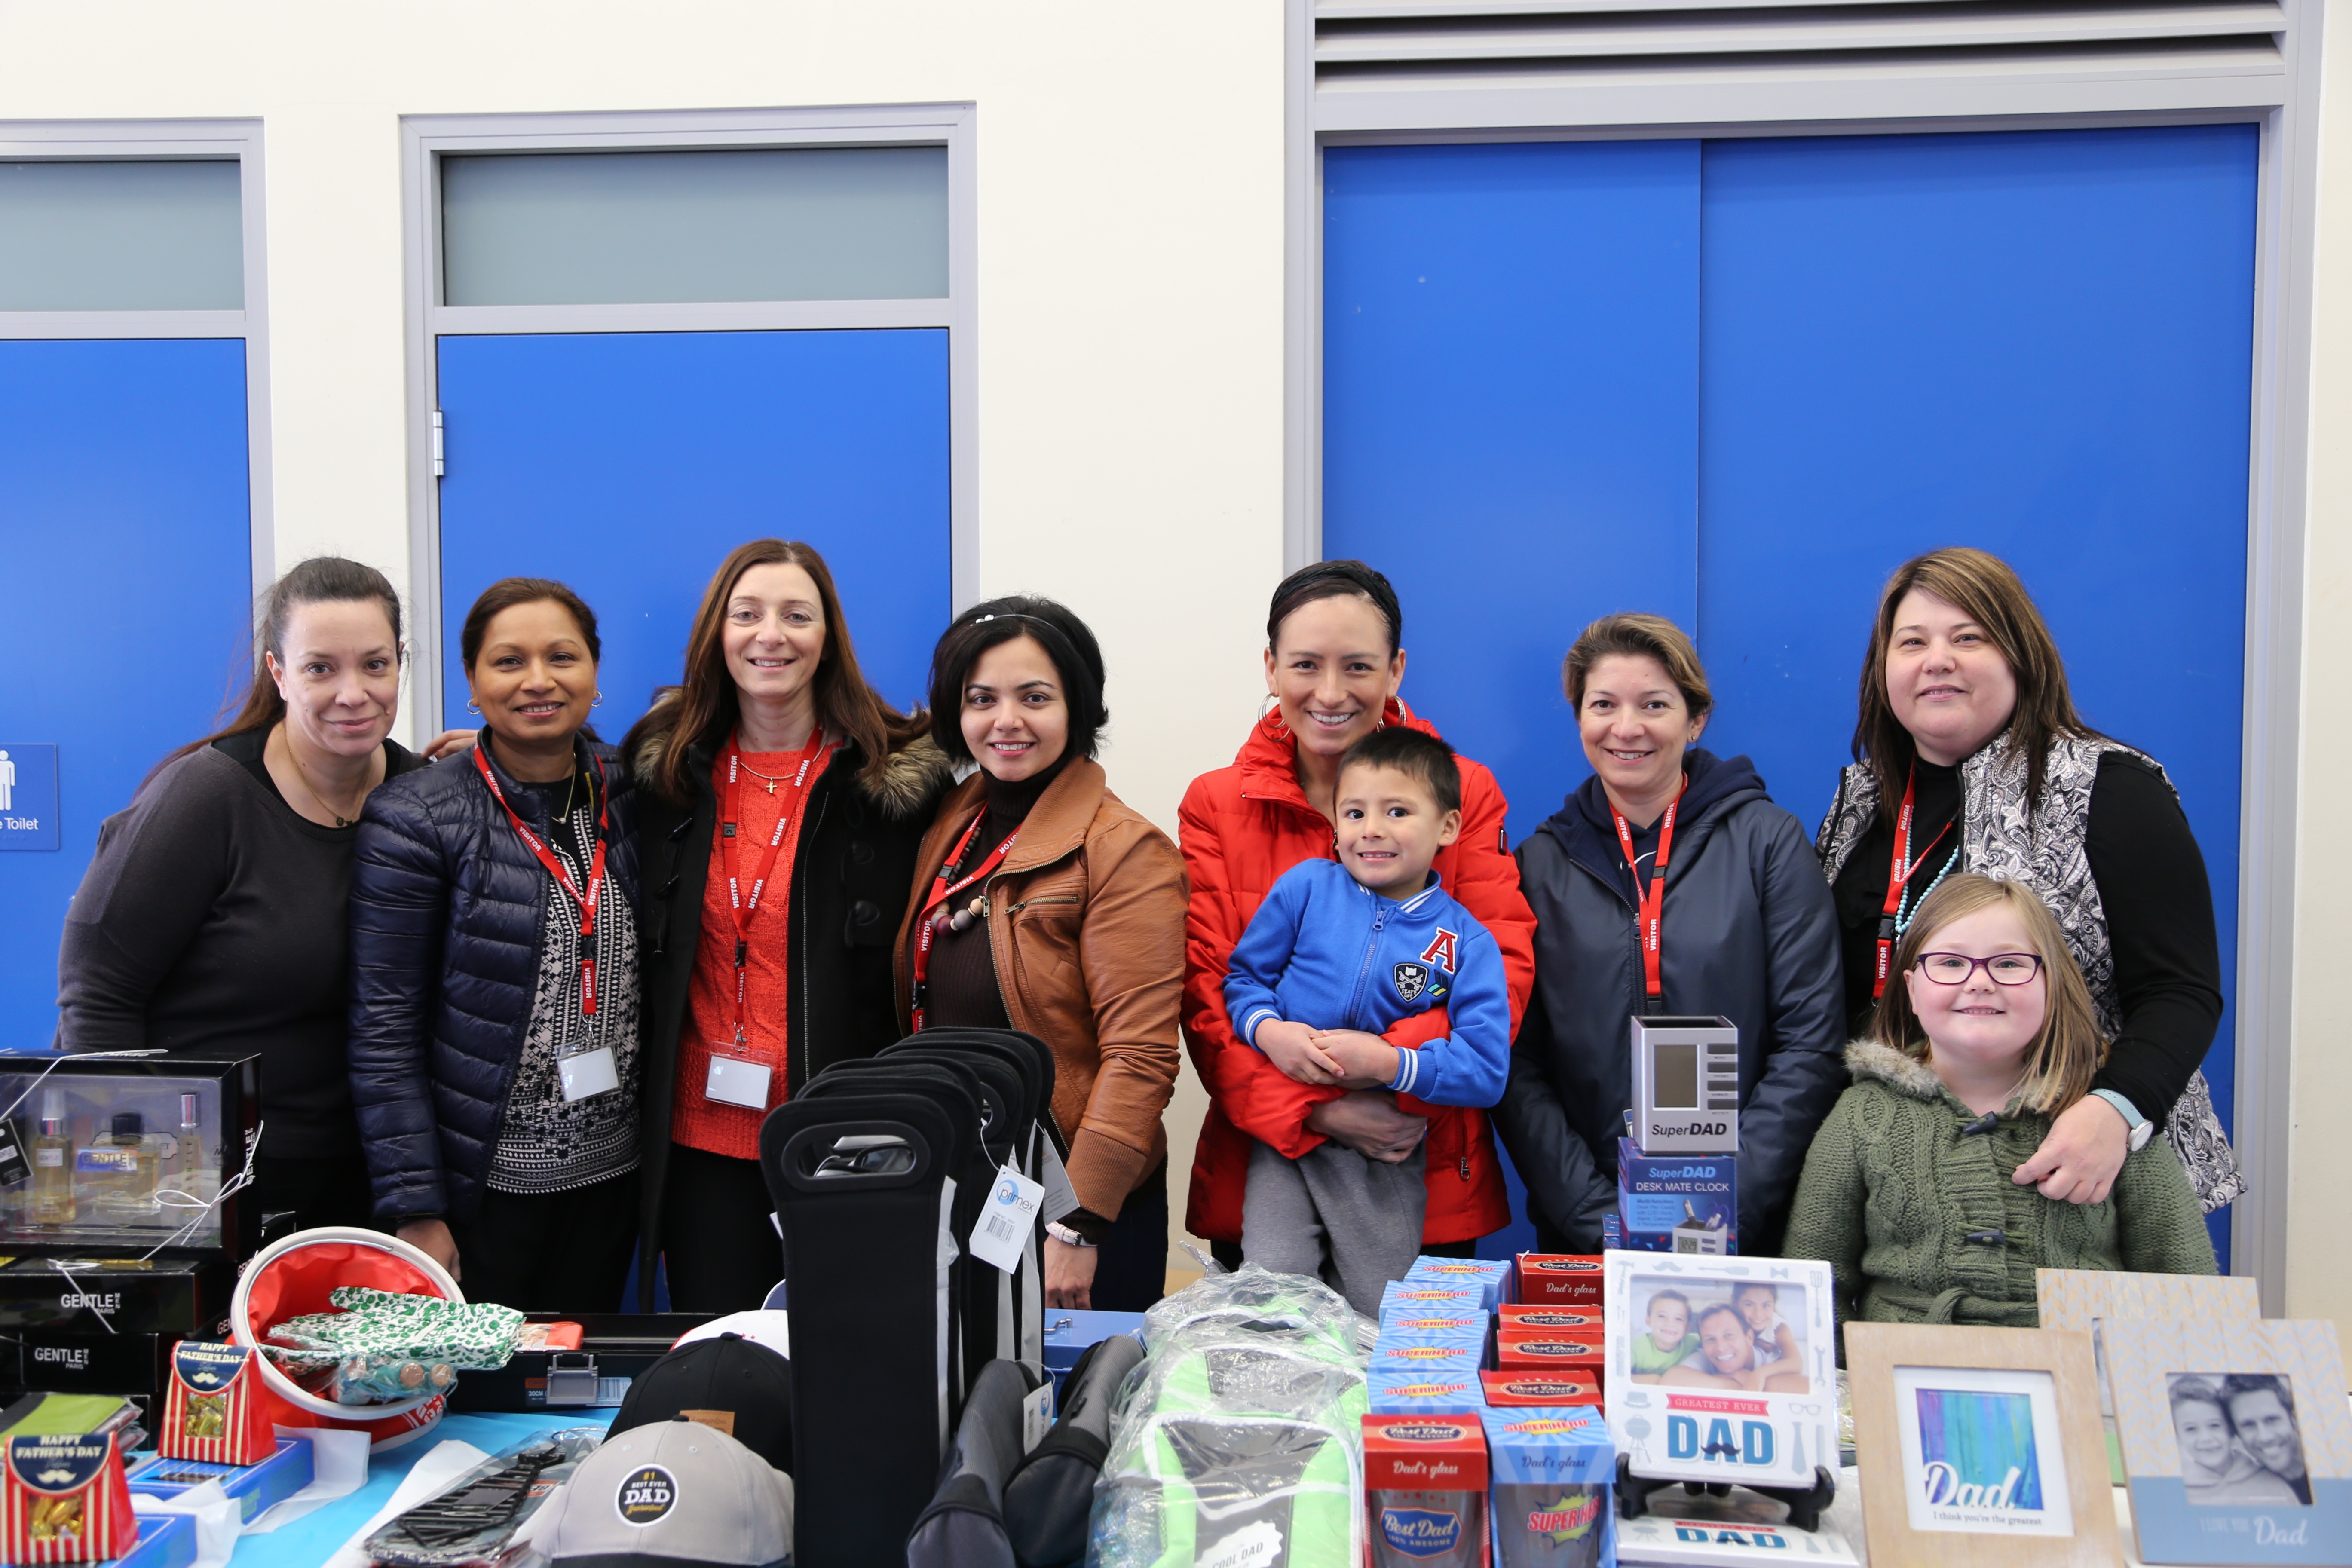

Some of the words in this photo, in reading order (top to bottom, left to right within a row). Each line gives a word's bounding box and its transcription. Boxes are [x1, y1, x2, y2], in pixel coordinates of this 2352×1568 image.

[729, 755, 738, 783] VISITOR
[794, 760, 810, 787] VISITOR
[486, 770, 502, 796] VISITOR
[4, 817, 39, 830] Toilet
[1664, 802, 1675, 829] VISITOR
[1900, 805, 1910, 830] VISITOR
[519, 826, 542, 852] VISITOR
[771, 818, 787, 846] VISITOR
[1617, 816, 1629, 841] VISITOR
[999, 833, 1018, 854] SITOR
[1893, 859, 1902, 882] VISITOR
[563, 877, 585, 904] VISITOR
[588, 878, 600, 906] VISITOR
[730, 877, 739, 909] VISITOR
[748, 879, 763, 909] VISITOR
[946, 876, 974, 894] VISITOR
[921, 920, 931, 951] VISITOR
[1419, 926, 1458, 975] A
[1878, 946, 1887, 979] VISITOR
[1651, 1122, 1727, 1137] SuperDAD
[1649, 1166, 1716, 1179] SuperDAD
[1636, 1182, 1663, 1191] DESK
[1665, 1183, 1692, 1191] MATE
[1694, 1183, 1729, 1192] CLOCK
[998, 1189, 1035, 1213] primex
[61, 1294, 114, 1308] GENTLE
[1546, 1283, 1572, 1293] Dad's
[1574, 1284, 1596, 1297] glass
[34, 1347, 82, 1363] GENTLE
[180, 1350, 220, 1362] FATHER'S
[222, 1354, 242, 1363] DAY
[199, 1342, 233, 1352] HAPPY
[1429, 1384, 1467, 1393] HERO
[1675, 1398, 1729, 1409] GREATEST
[1733, 1402, 1761, 1412] EVER
[1503, 1424, 1550, 1432] SUPER
[1550, 1419, 1589, 1429] HERO
[40, 1435, 83, 1446] HAPPY
[1667, 1415, 1774, 1464] DAD
[16, 1447, 75, 1458] FATHER'S
[76, 1446, 103, 1458] DAY
[1393, 1460, 1427, 1474] Dad's
[1430, 1460, 1458, 1479] glass
[1522, 1455, 1555, 1468] Dad's
[1558, 1456, 1586, 1473] glass
[624, 1488, 671, 1504] DAD
[1923, 1461, 2021, 1509] Dad
[1385, 1513, 1416, 1537] Best
[1418, 1517, 1456, 1537] Dad
[1527, 1509, 1579, 1532] SUPER
[1939, 1512, 1961, 1521] think
[1964, 1514, 1990, 1523] you're
[1992, 1514, 2006, 1523] the
[2009, 1517, 2042, 1526] greatest
[2254, 1515, 2309, 1545] Dad
[1675, 1527, 1787, 1548] DAD
[1213, 1554, 1237, 1568] COOL
[1241, 1542, 1263, 1560] DAD
